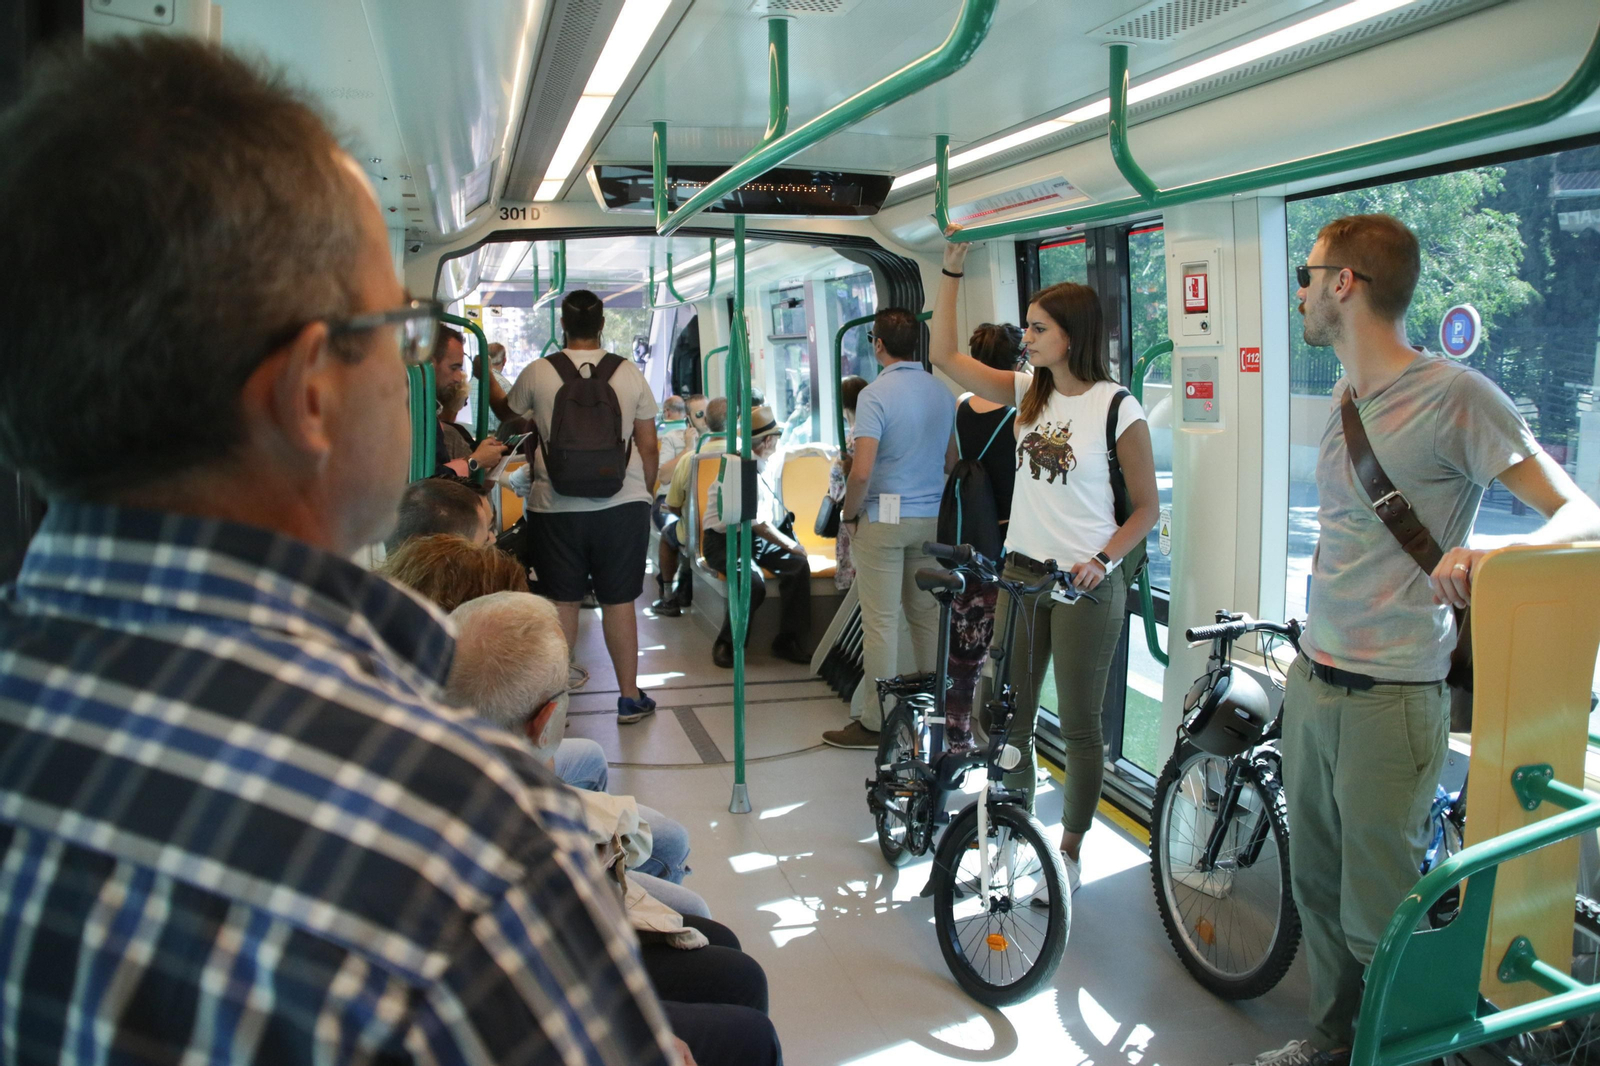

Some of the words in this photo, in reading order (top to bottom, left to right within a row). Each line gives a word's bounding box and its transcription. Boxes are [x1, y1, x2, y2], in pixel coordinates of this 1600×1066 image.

[499, 206, 526, 220] 301
[1454, 322, 1463, 335] P
[1247, 353, 1260, 363] 112
